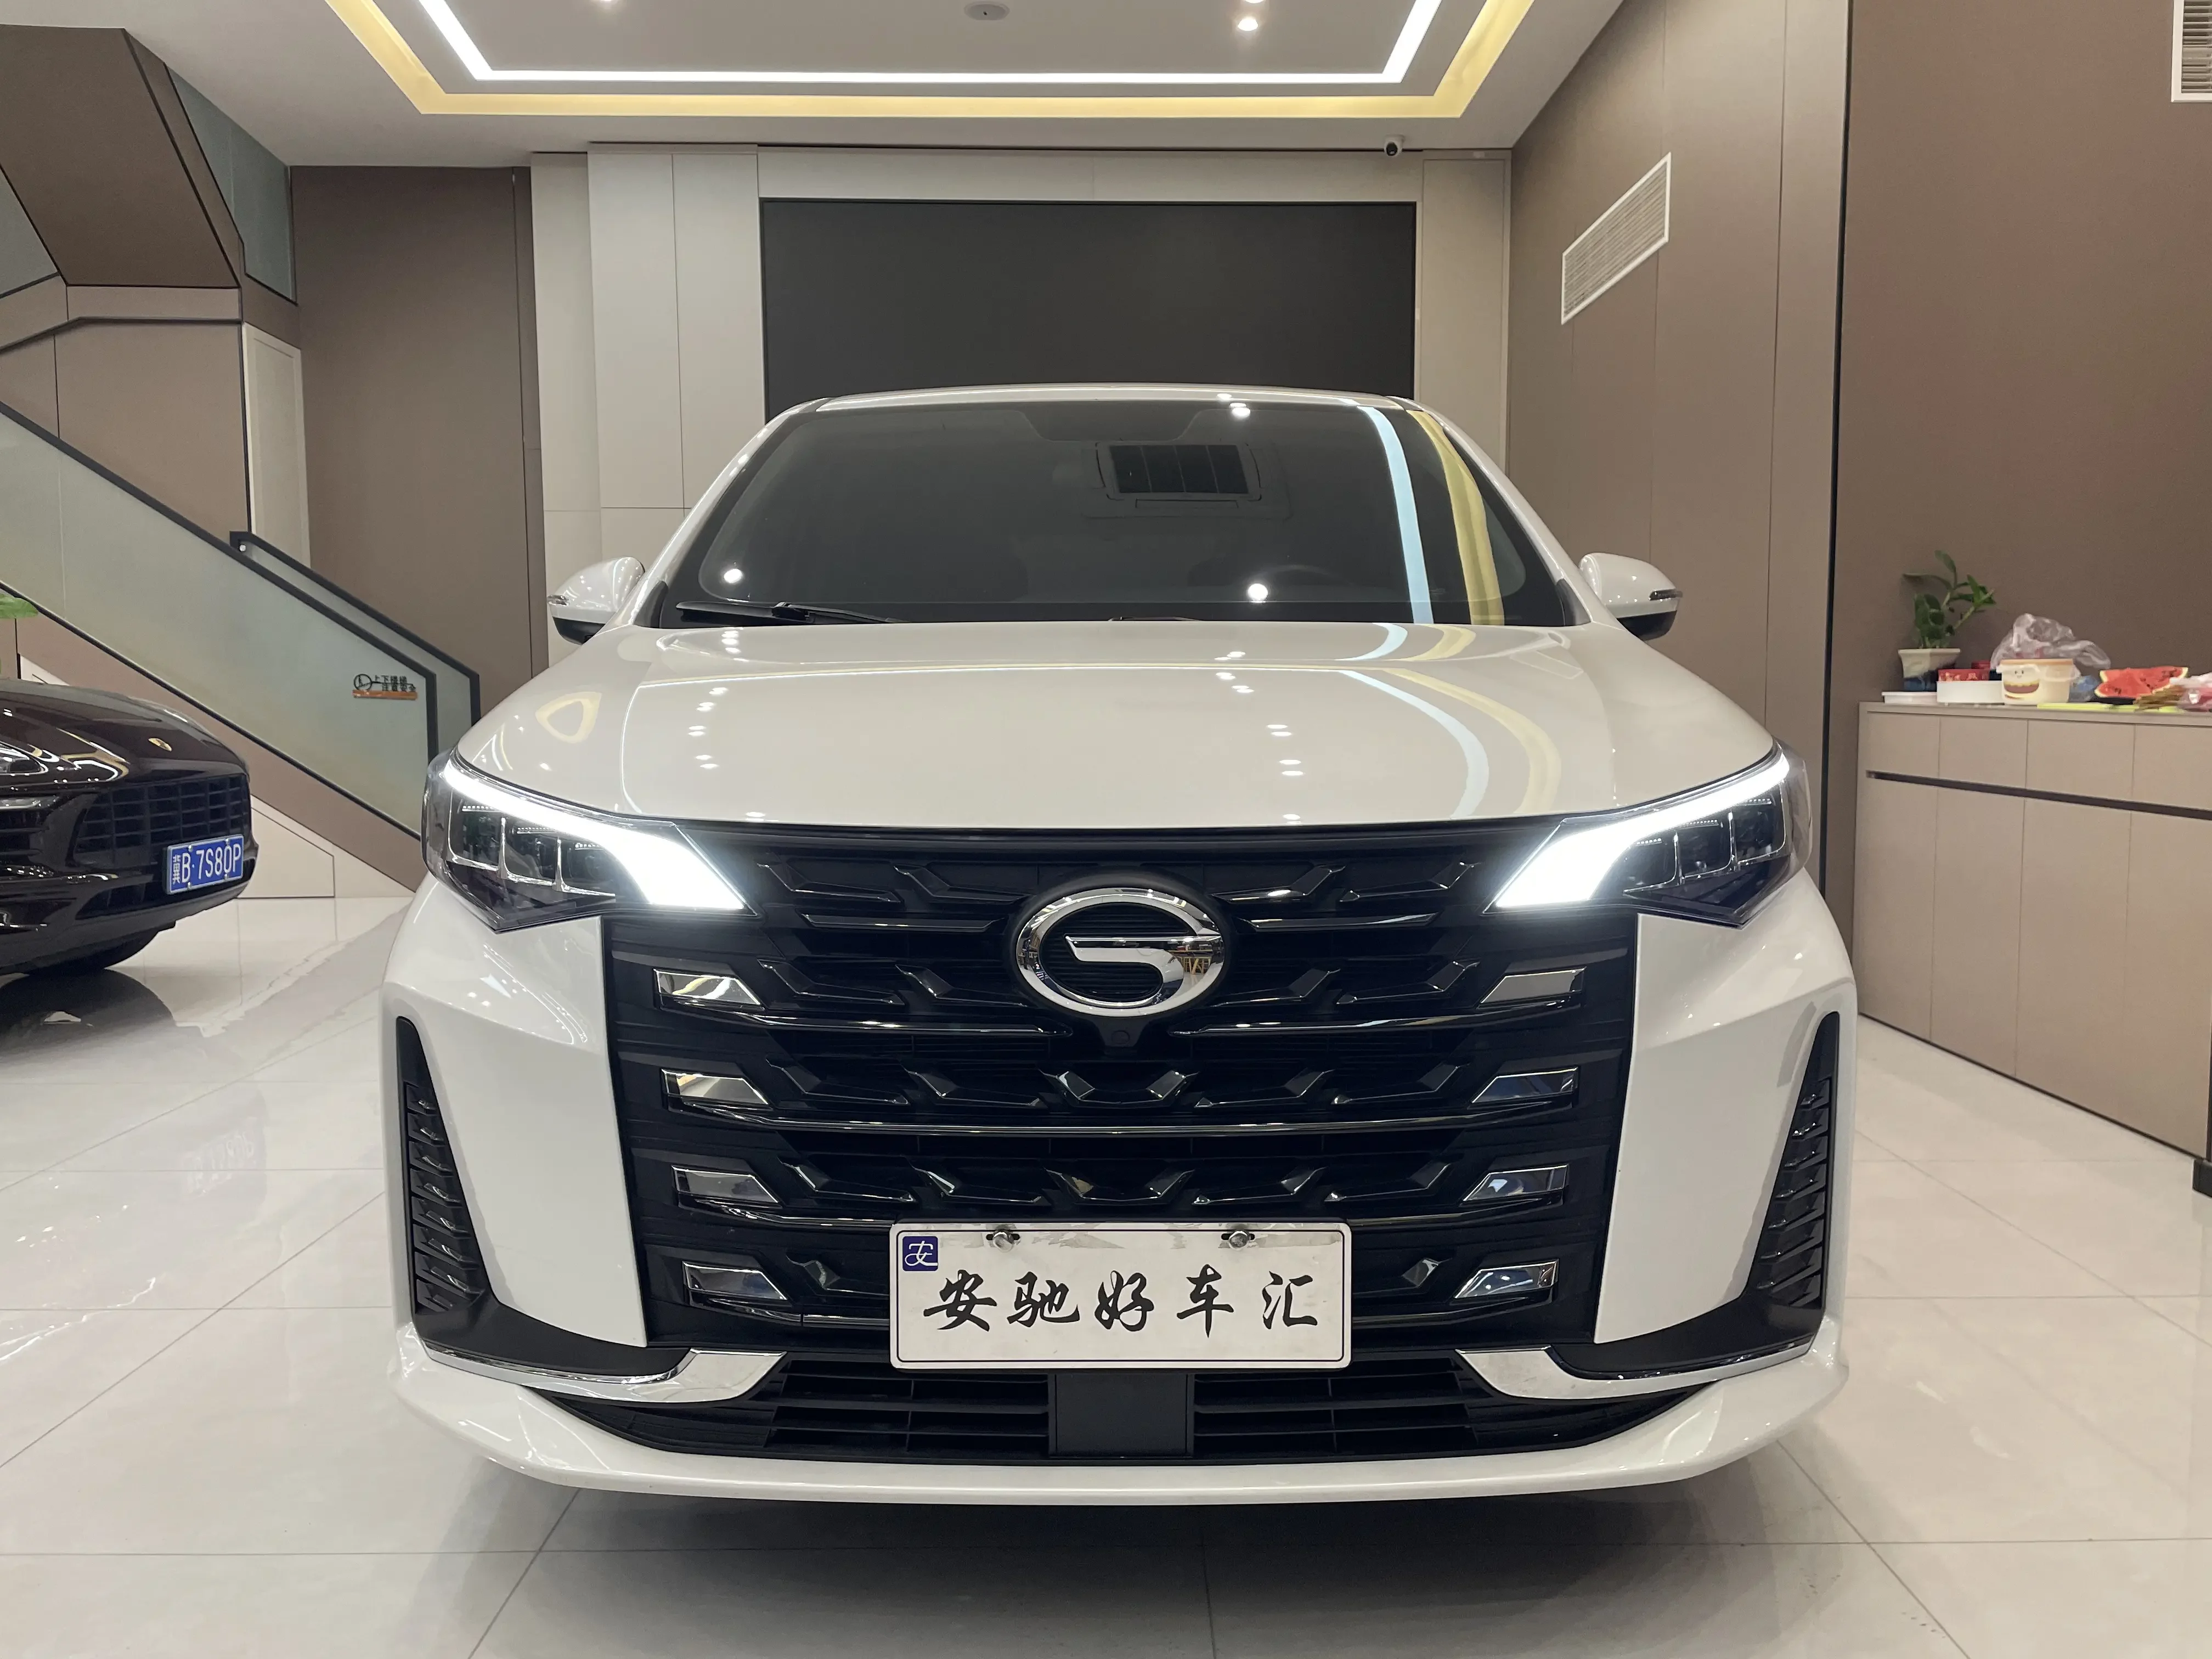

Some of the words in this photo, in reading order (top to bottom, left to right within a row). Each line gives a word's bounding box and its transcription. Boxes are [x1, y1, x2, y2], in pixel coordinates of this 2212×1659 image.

[924, 1264, 1318, 1338] 安驰好车汇
